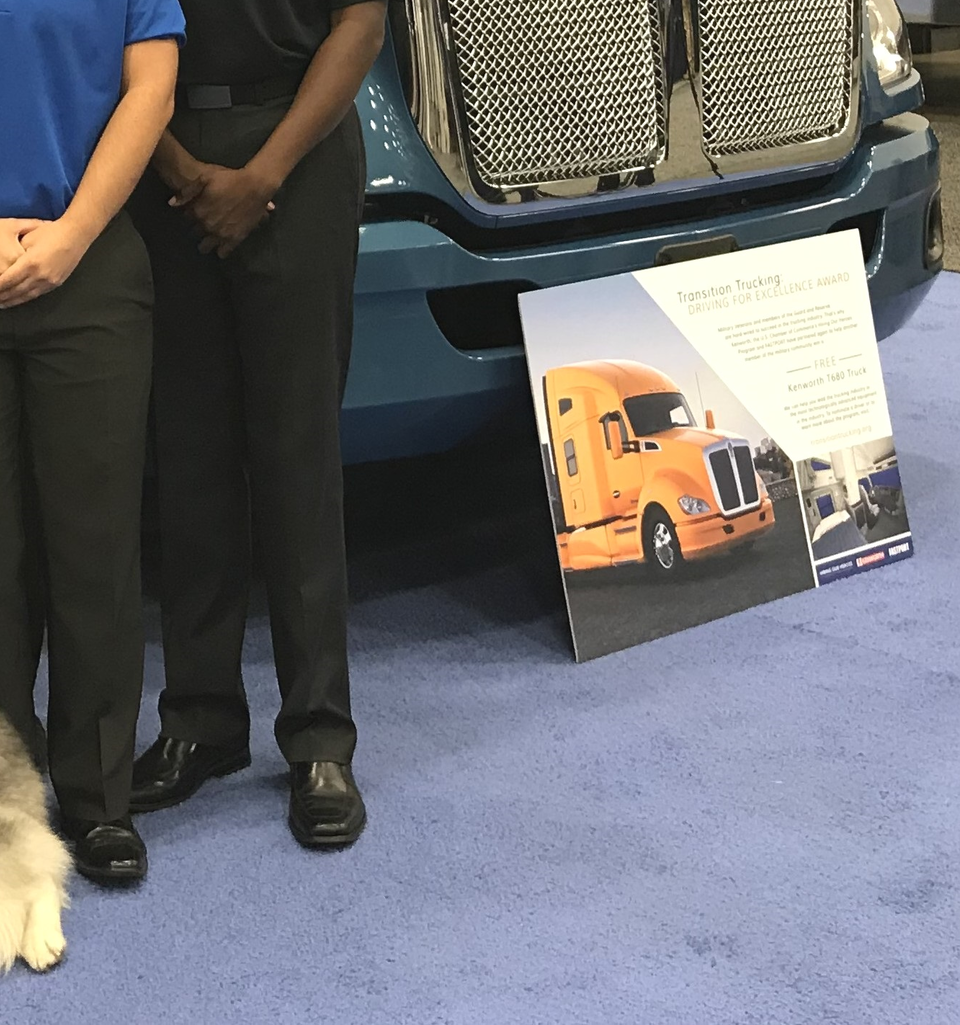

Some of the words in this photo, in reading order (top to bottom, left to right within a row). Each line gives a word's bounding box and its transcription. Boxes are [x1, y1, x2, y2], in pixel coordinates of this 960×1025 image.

[677, 284, 732, 303] Transition
[736, 274, 783, 291] Trucking:
[688, 296, 730, 315] DRIVING
[733, 292, 752, 305] FOR
[756, 279, 814, 301] EXCELLENCE
[817, 272, 850, 287] AWARD
[814, 356, 836, 370] FREE
[788, 376, 824, 392] Kenworth
[827, 371, 845, 382] T680
[847, 366, 866, 378] Truck
